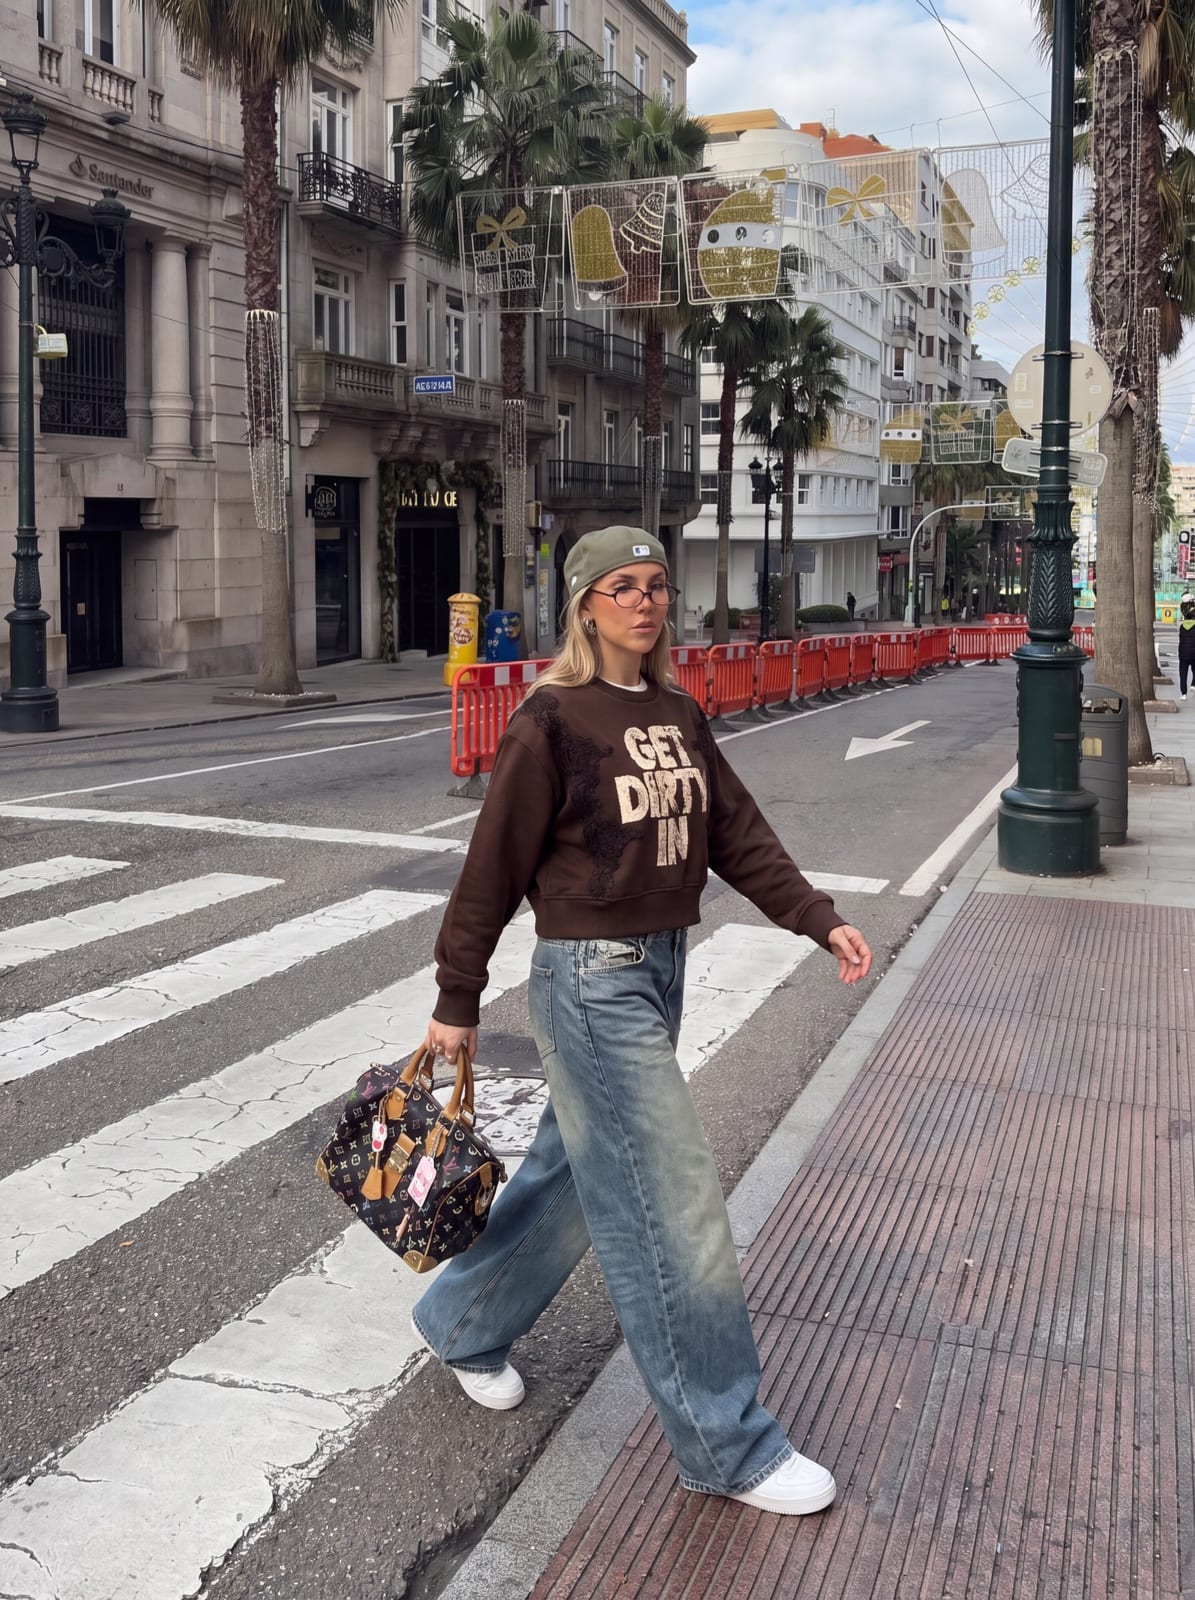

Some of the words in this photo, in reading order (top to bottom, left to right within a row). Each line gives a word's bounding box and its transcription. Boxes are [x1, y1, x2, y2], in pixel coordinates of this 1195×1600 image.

[89, 163, 154, 199] Santander
[624, 725, 692, 770] GET
[614, 767, 707, 824] DIRTY
[656, 815, 689, 866] IN
